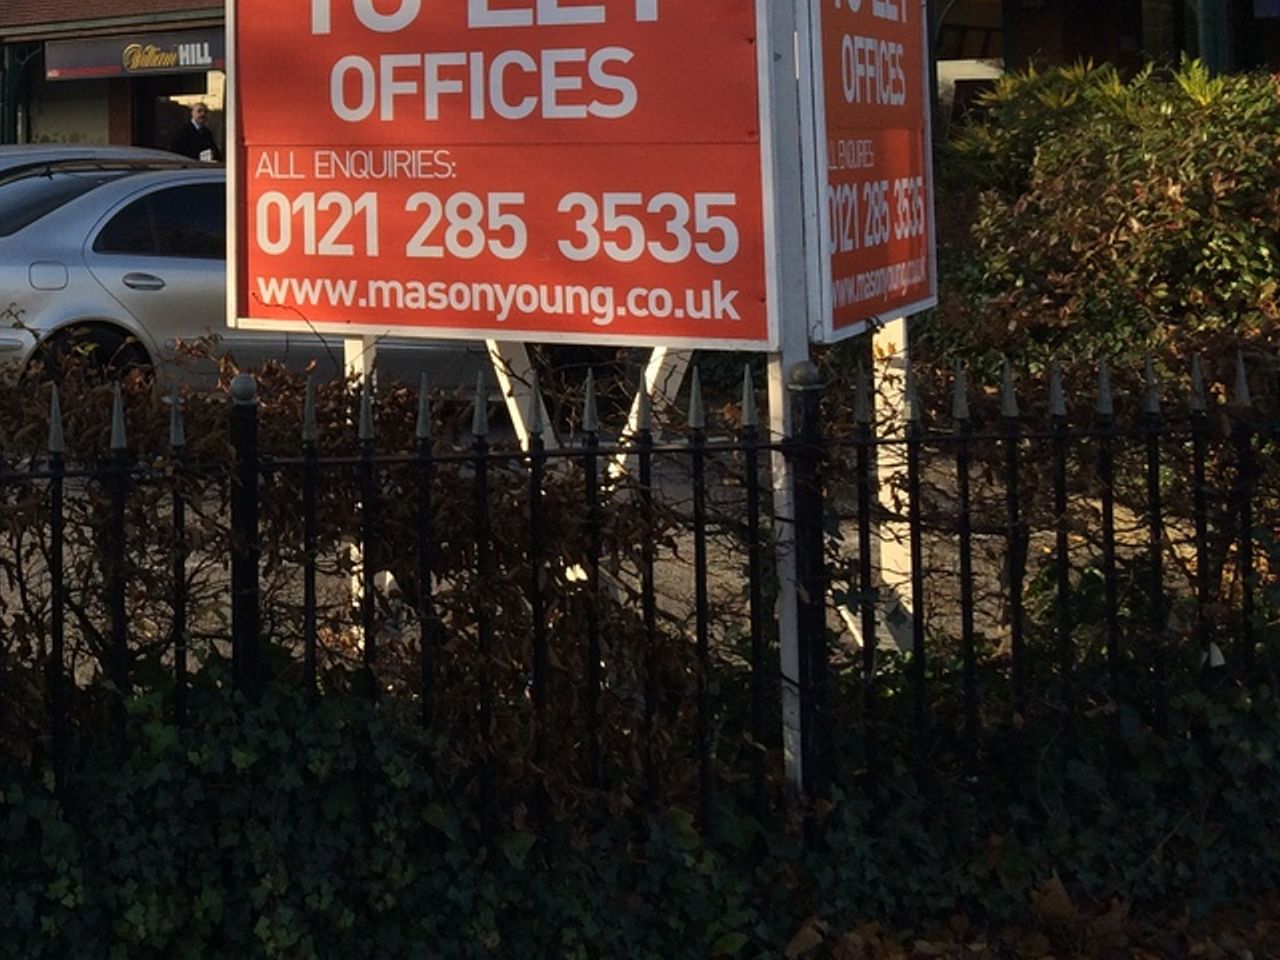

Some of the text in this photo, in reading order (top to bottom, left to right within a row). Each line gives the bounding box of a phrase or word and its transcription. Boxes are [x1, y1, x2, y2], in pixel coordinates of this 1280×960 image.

[178, 42, 212, 66] HILL
[329, 46, 639, 123] OFFICES
[841, 33, 907, 107] OFFICES
[255, 149, 457, 180] ALL ENQUIRIES:
[255, 191, 740, 265] 0121 285 3535
[863, 179, 890, 248] 285
[893, 176, 925, 241] 3535
[256, 276, 742, 326] www.masonyoung.co.uk
